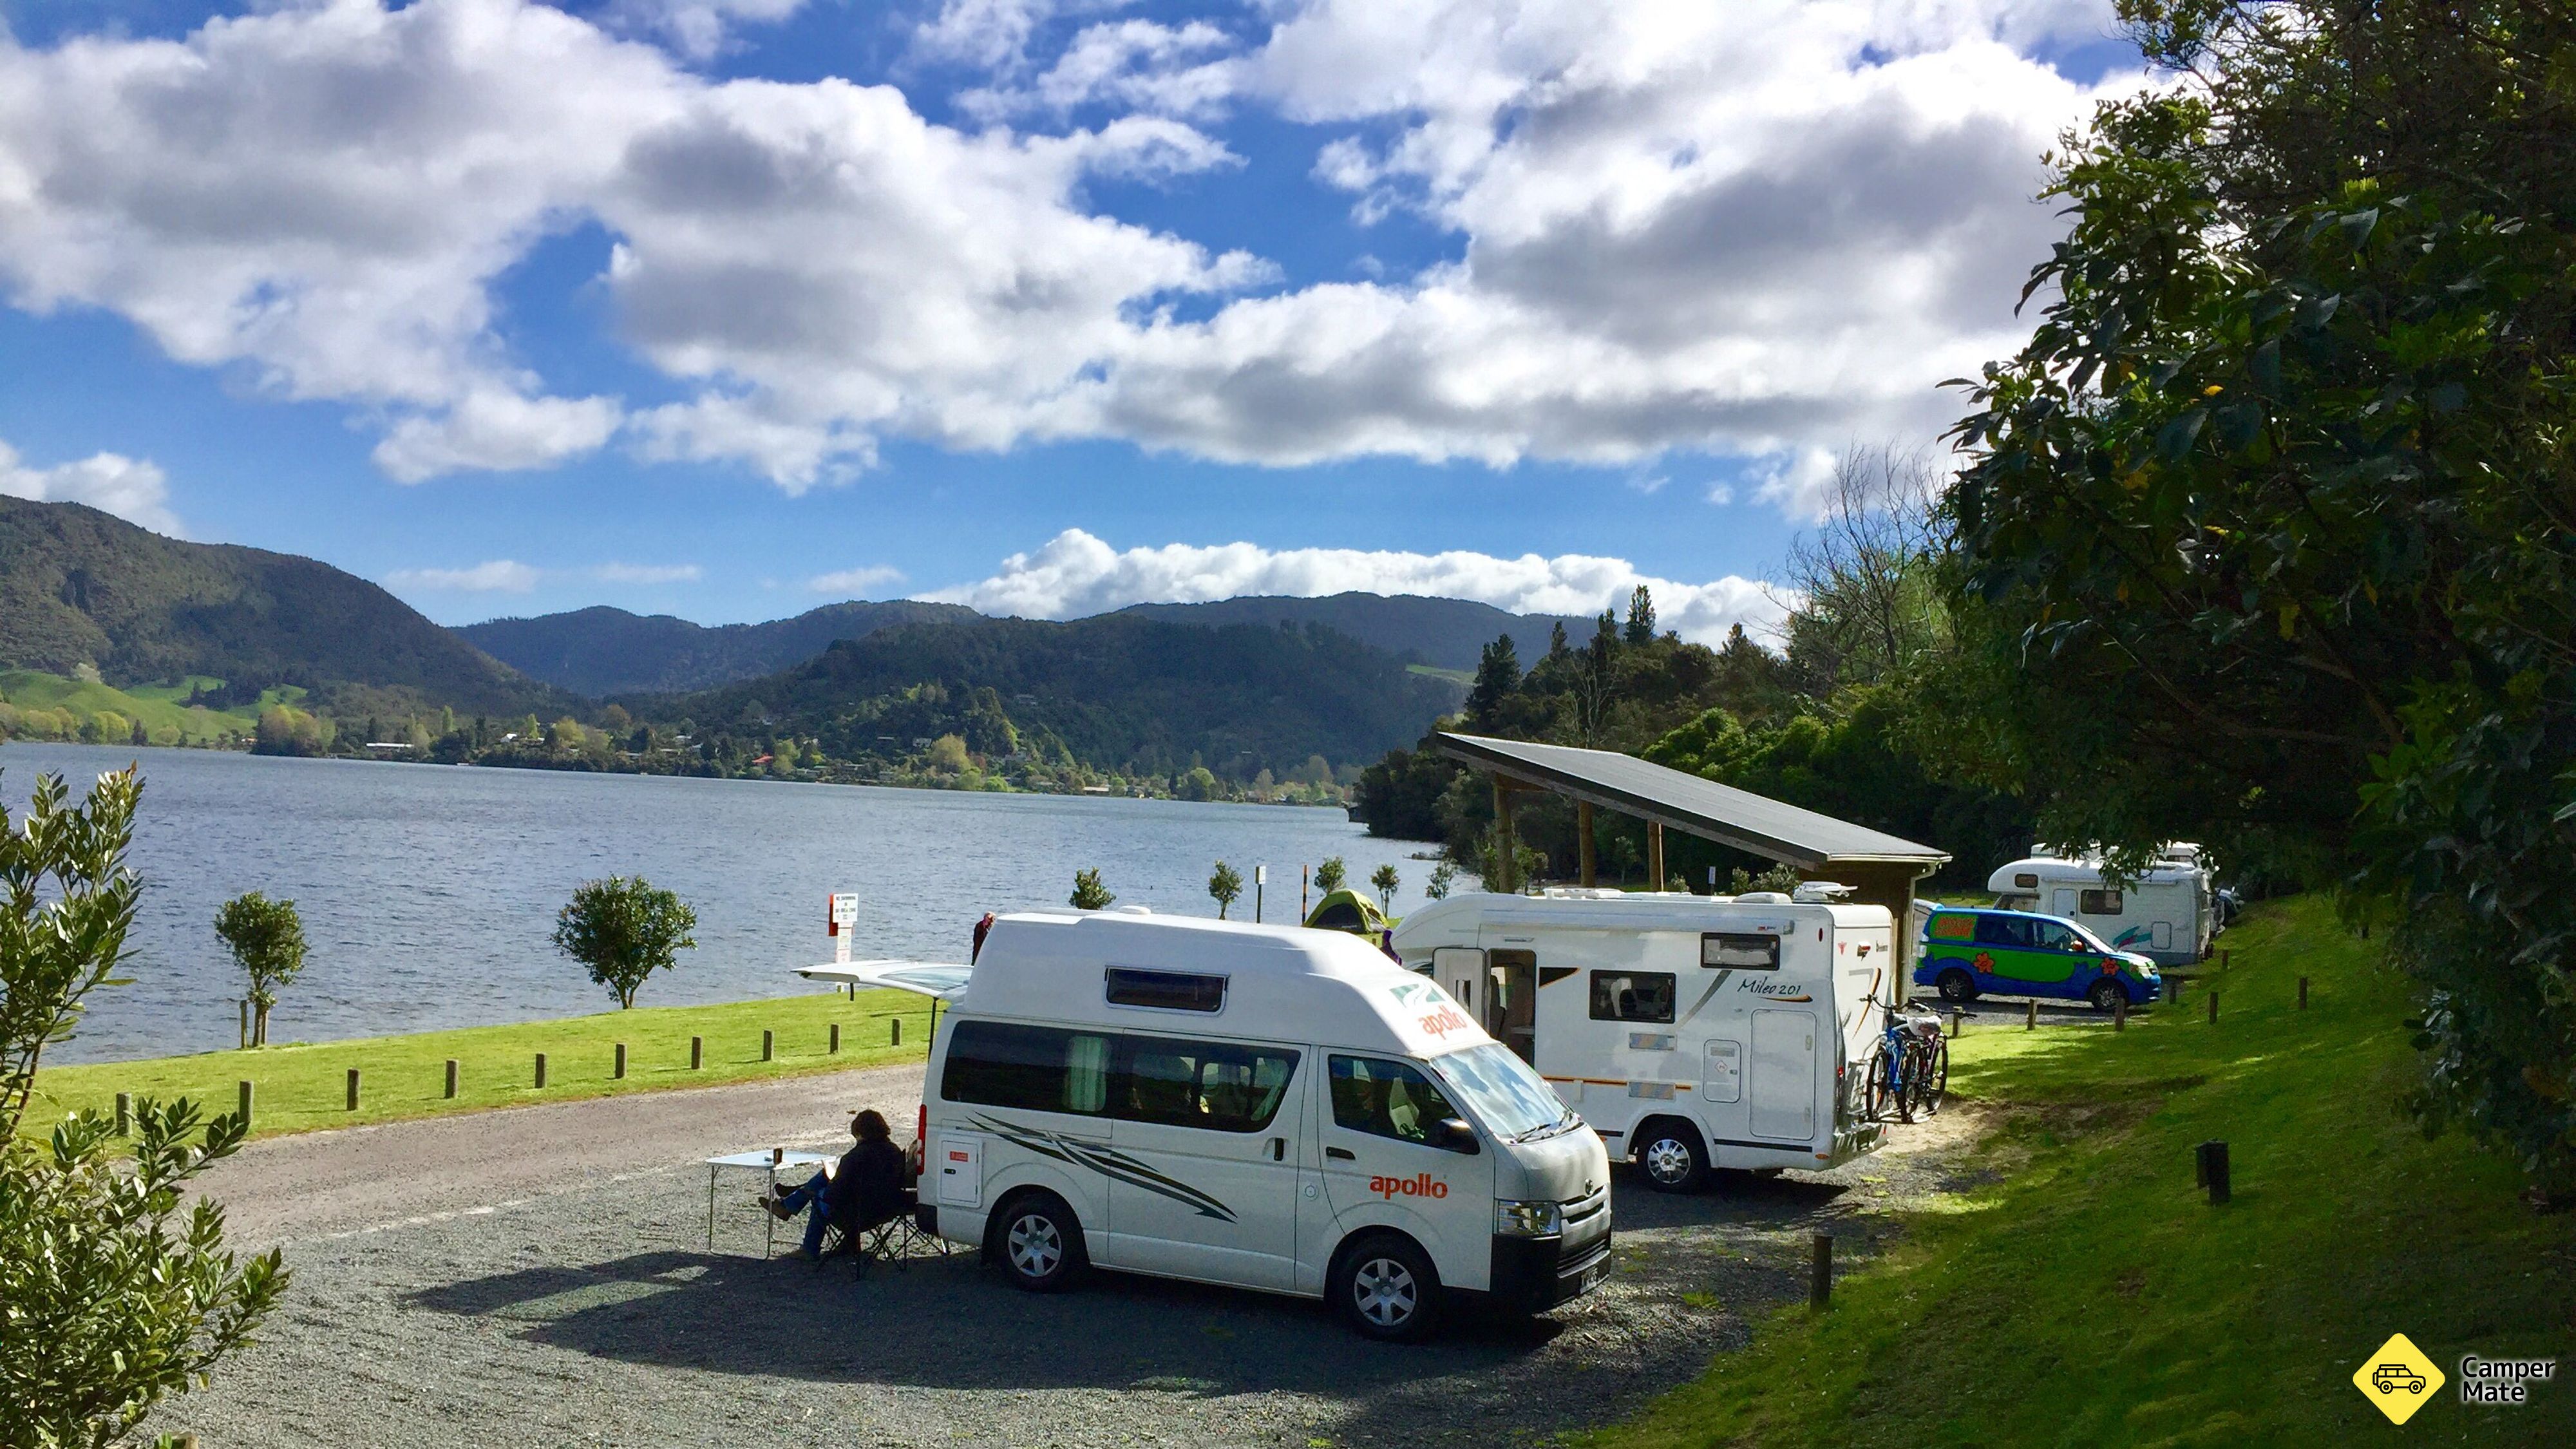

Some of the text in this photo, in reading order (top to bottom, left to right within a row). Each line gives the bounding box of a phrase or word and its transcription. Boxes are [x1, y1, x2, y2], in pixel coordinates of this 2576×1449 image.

[1737, 976, 1801, 995] Mileo 201
[1418, 1004, 1468, 1040] apollo
[1369, 1173, 1448, 1200] apollo
